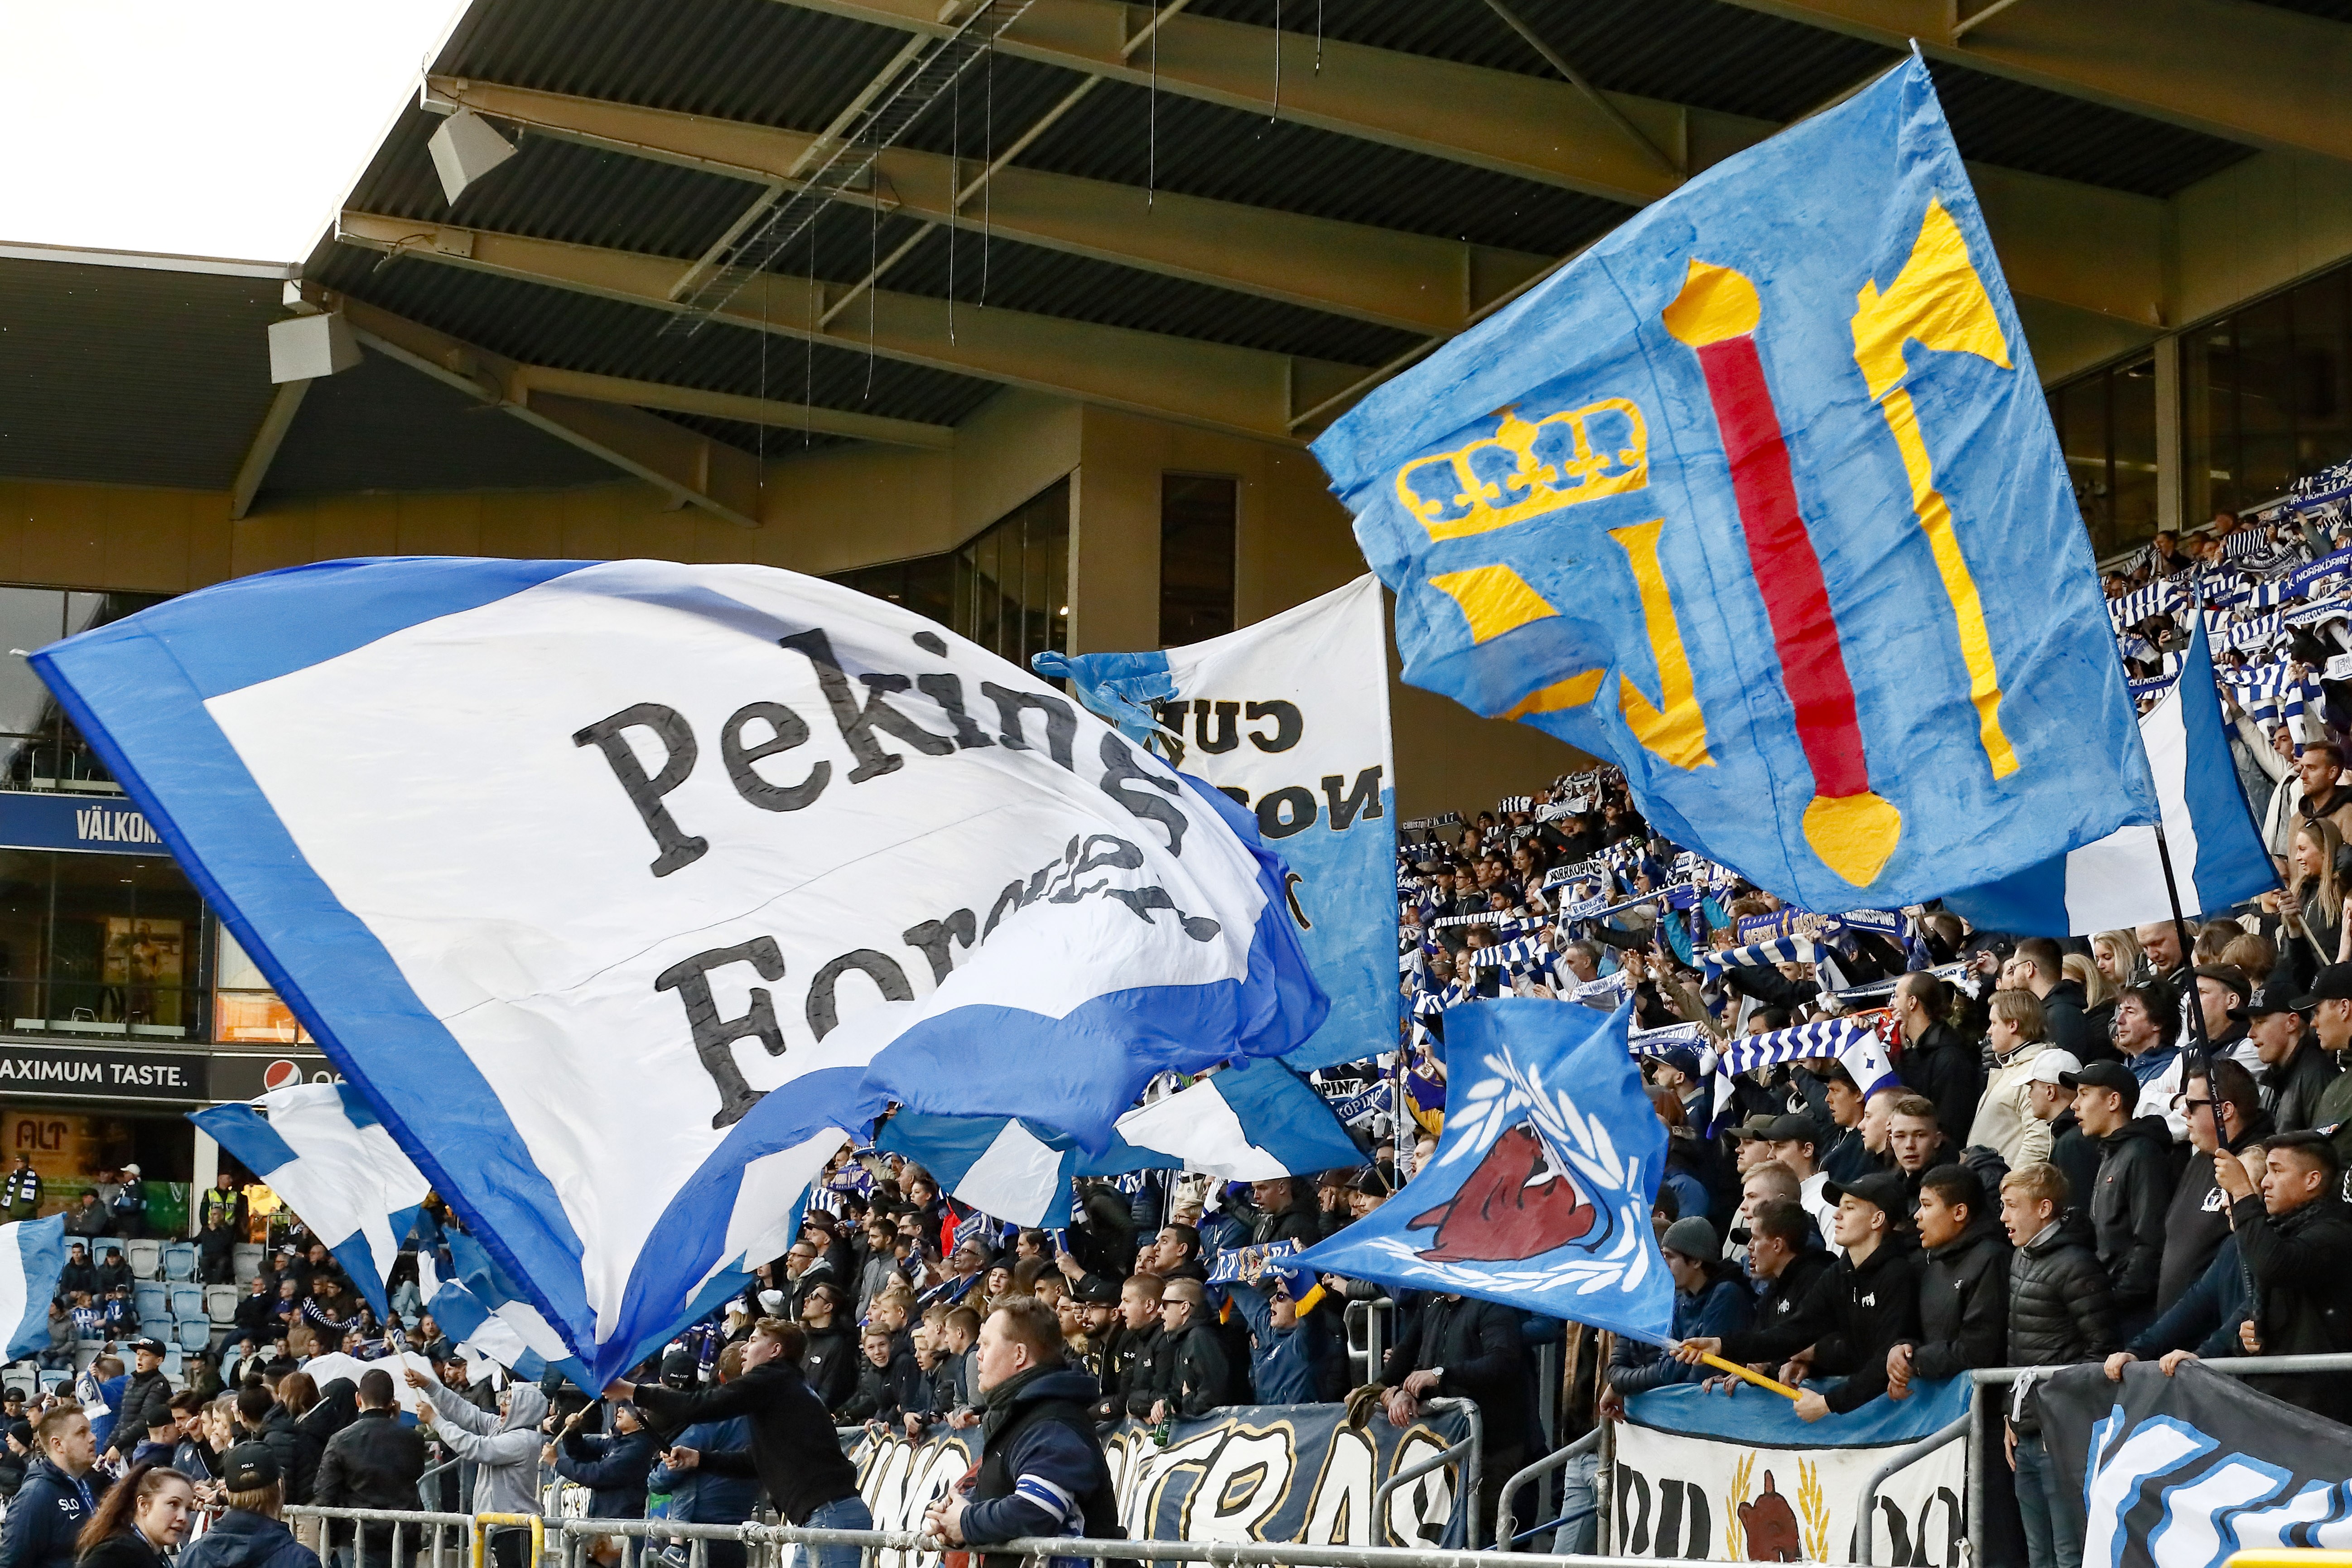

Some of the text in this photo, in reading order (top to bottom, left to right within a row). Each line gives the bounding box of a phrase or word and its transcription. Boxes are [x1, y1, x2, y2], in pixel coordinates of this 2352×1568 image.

[2290, 496, 2303, 505] IFK
[2296, 553, 2350, 584] NORRKÖPING
[2335, 656, 2352, 674] IFK
[1743, 923, 1778, 947] SVENSKA
[110, 1063, 188, 1087] TASTE.
[16, 1120, 67, 1150] ALT
[57, 1497, 80, 1512] SLO
